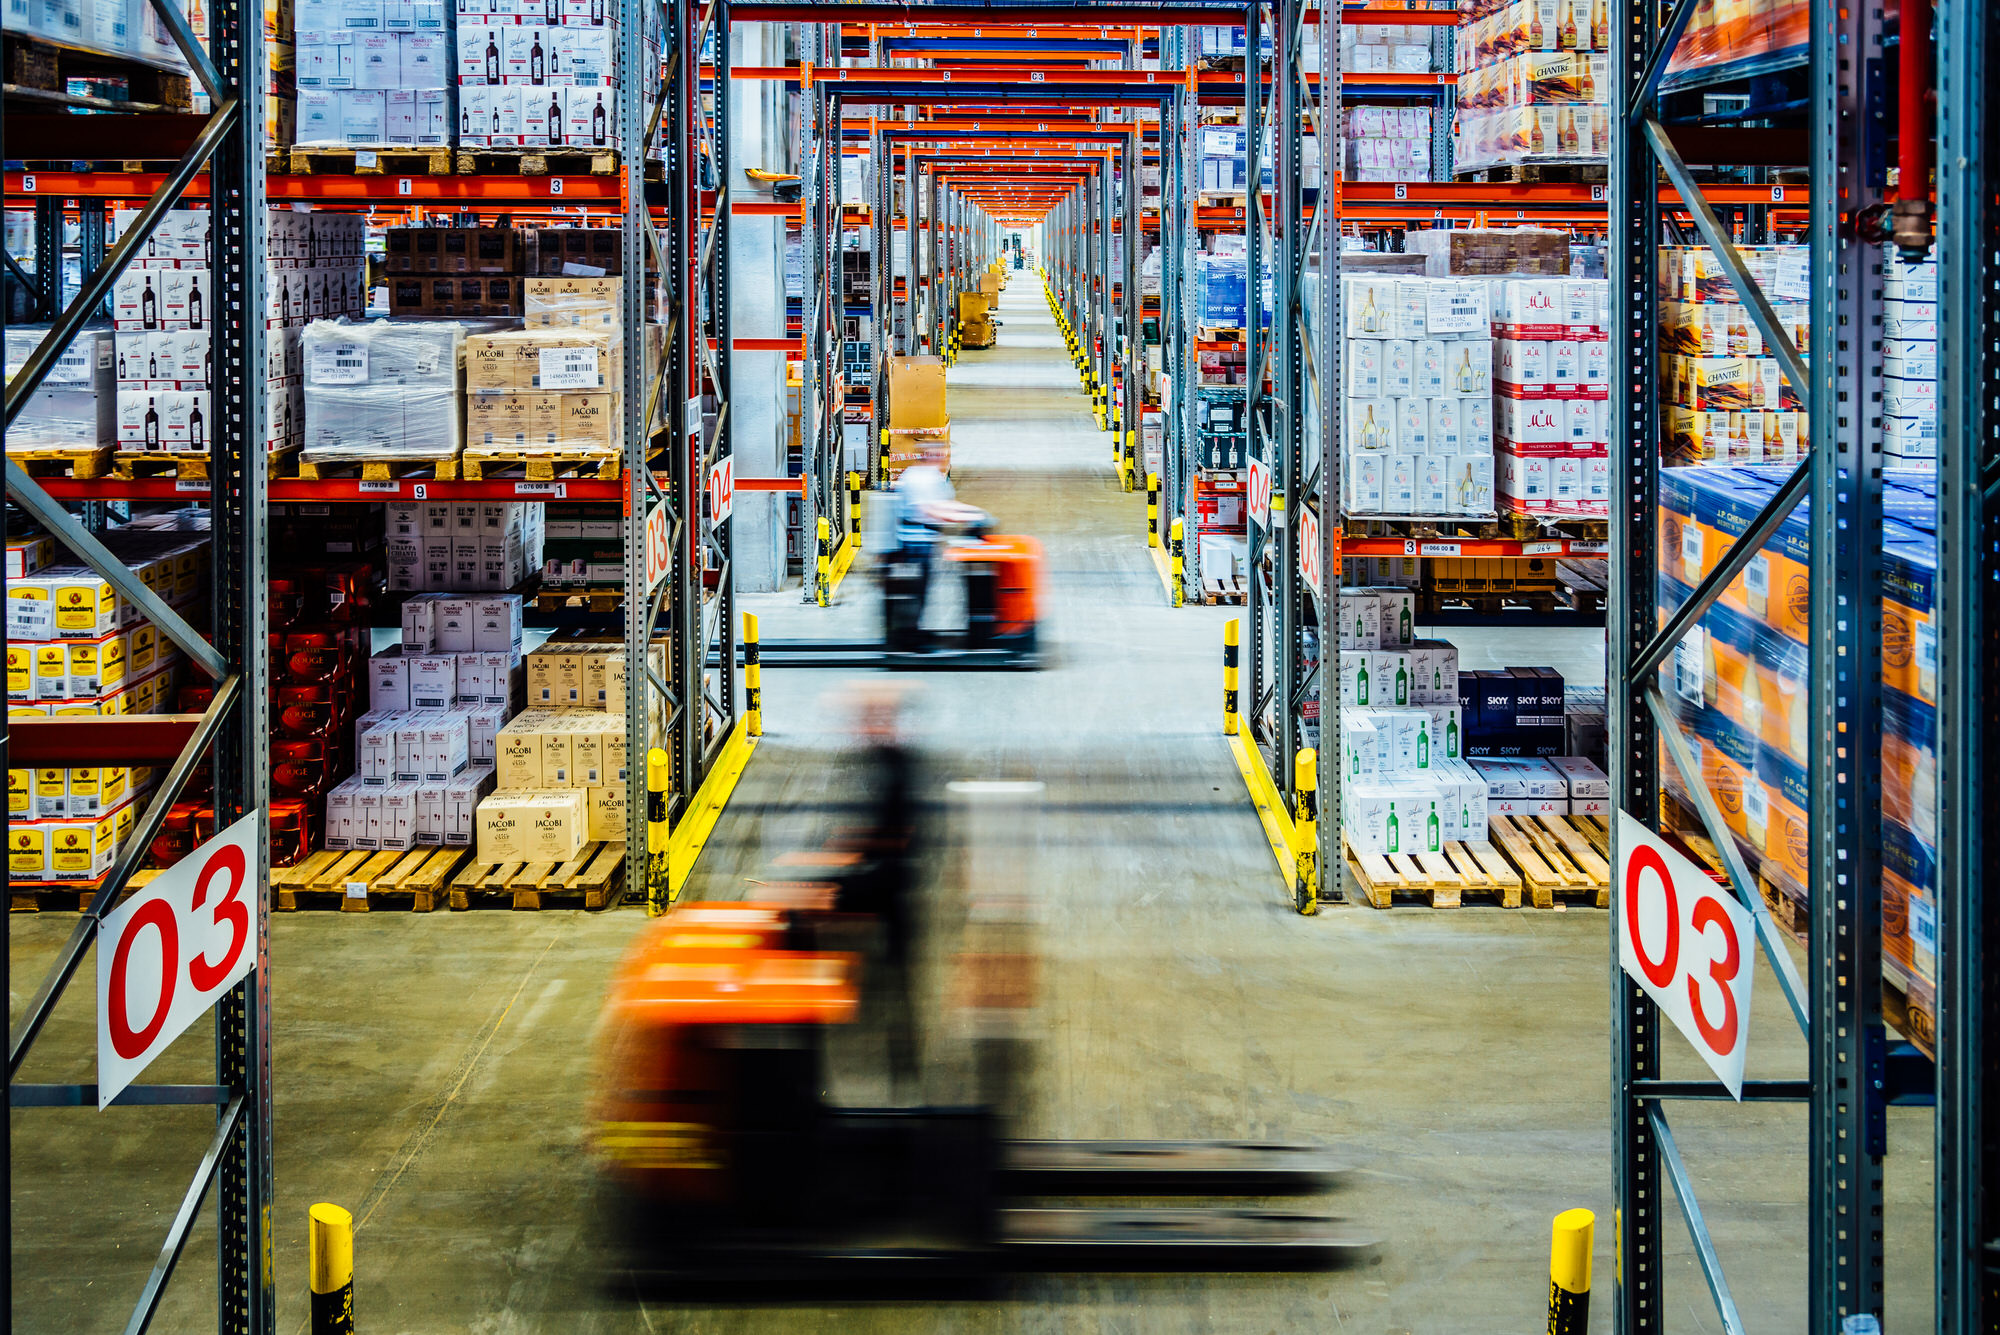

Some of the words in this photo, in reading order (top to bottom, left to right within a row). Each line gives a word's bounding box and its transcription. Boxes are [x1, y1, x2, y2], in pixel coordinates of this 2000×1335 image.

[25, 178, 33, 189] 5
[402, 180, 408, 192] 1
[553, 180, 560, 192] 3
[1396, 187, 1404, 197] 5
[1774, 188, 1781, 199] 9
[834, 375, 844, 410] 05
[572, 408, 599, 416] JACOBI
[416, 486, 425, 498] 9
[557, 485, 564, 496] 1
[712, 461, 731, 522] 04
[1250, 464, 1268, 524] 04
[647, 509, 668, 584] 03
[1301, 512, 1318, 586] 03
[1406, 542, 1414, 552] 3
[1888, 572, 1924, 593] CHENET
[292, 656, 324, 664] ROUGE
[1488, 697, 1508, 705] SKYY
[1517, 697, 1538, 705] SKYY
[1541, 697, 1561, 705] SKYY
[284, 709, 316, 718] ROUGE
[488, 820, 515, 828] JACOBI
[154, 839, 182, 847] OUGE
[1884, 840, 1919, 868] CHENET
[108, 844, 249, 1060] 03
[1626, 844, 1740, 1057] 03
